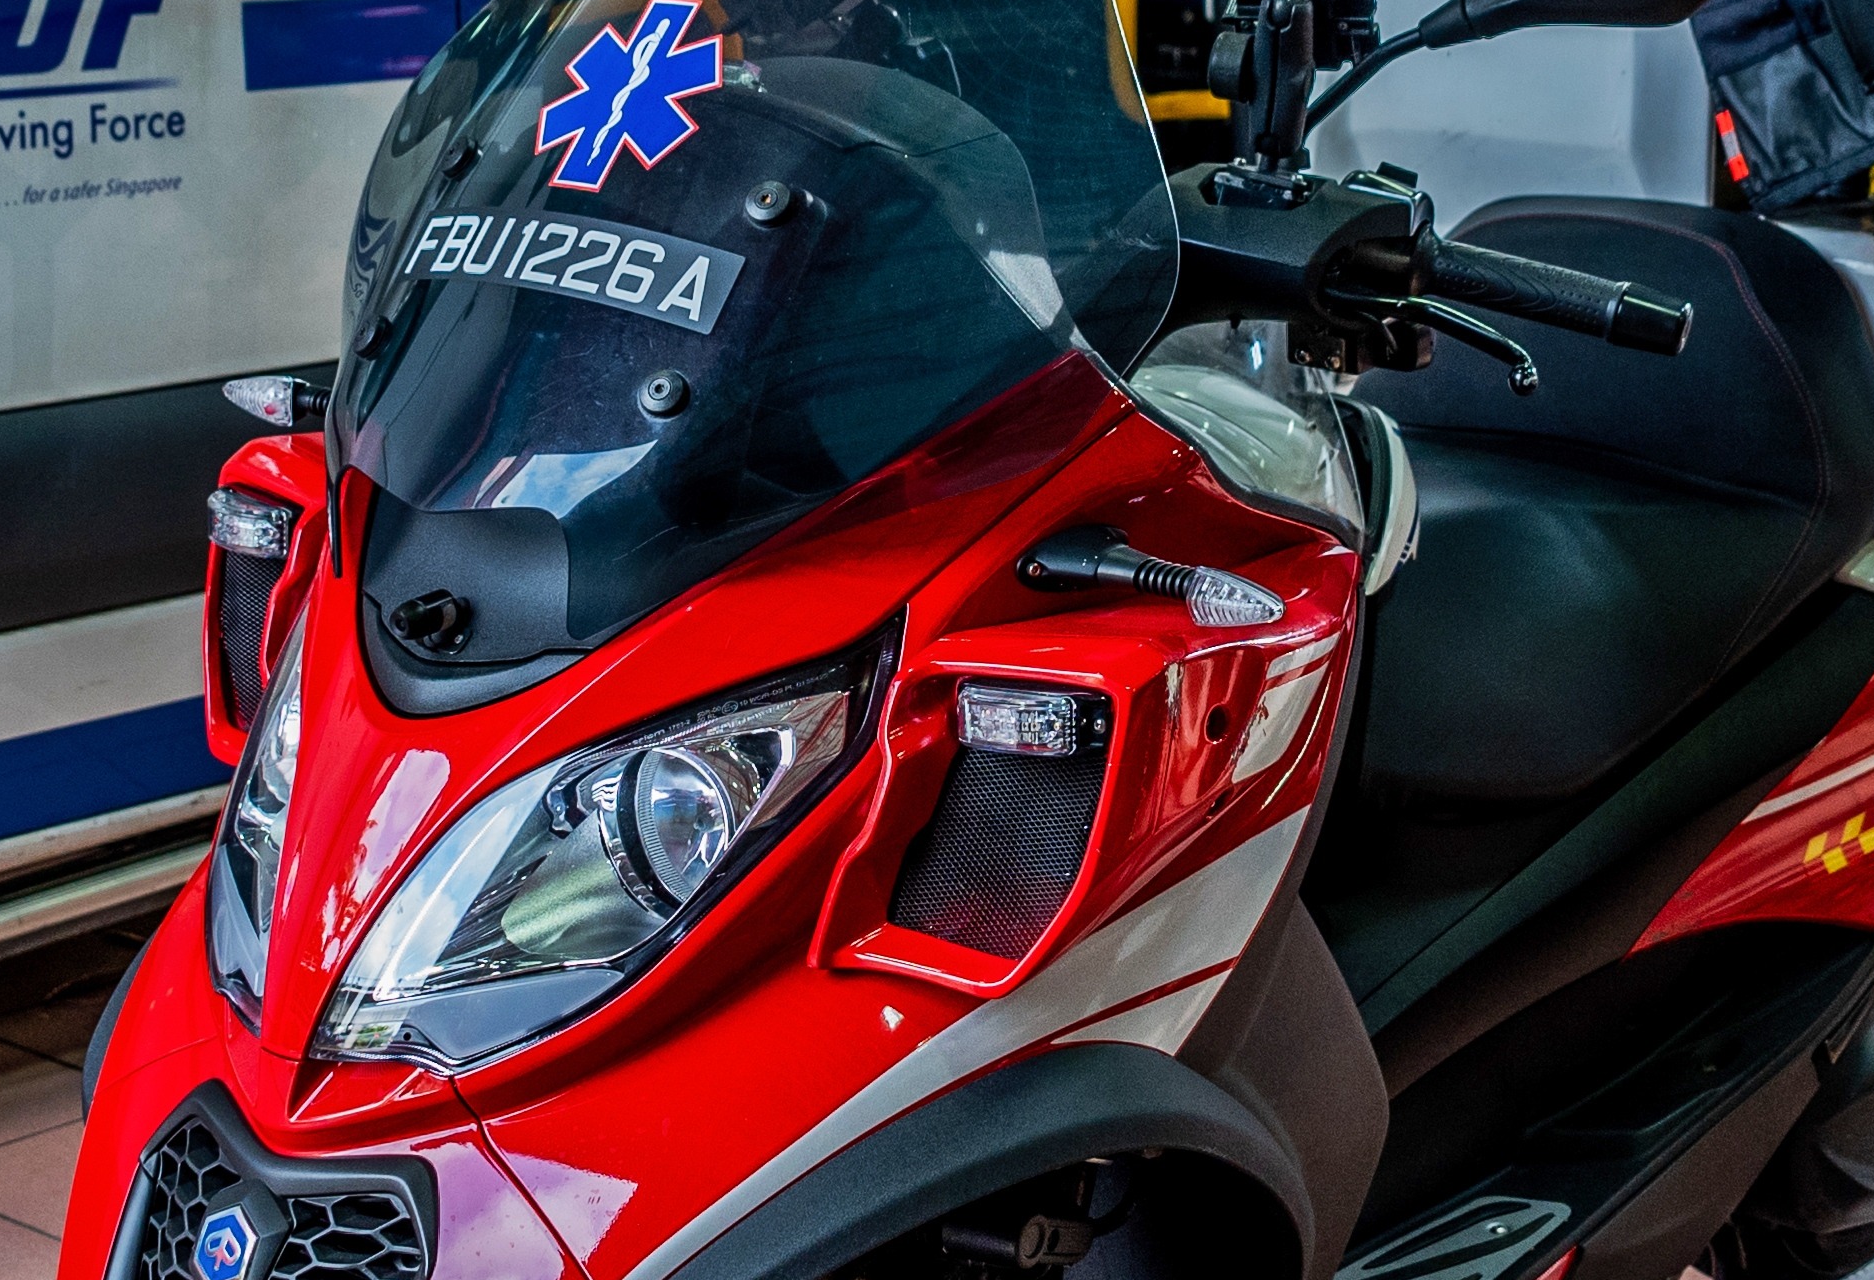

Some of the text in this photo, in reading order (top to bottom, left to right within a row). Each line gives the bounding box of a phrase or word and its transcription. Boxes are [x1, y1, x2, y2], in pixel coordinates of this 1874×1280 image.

[89, 103, 187, 144] Force
[61, 181, 104, 202] safer
[106, 173, 183, 201] Singapore
[404, 215, 711, 322] FBU1226A
